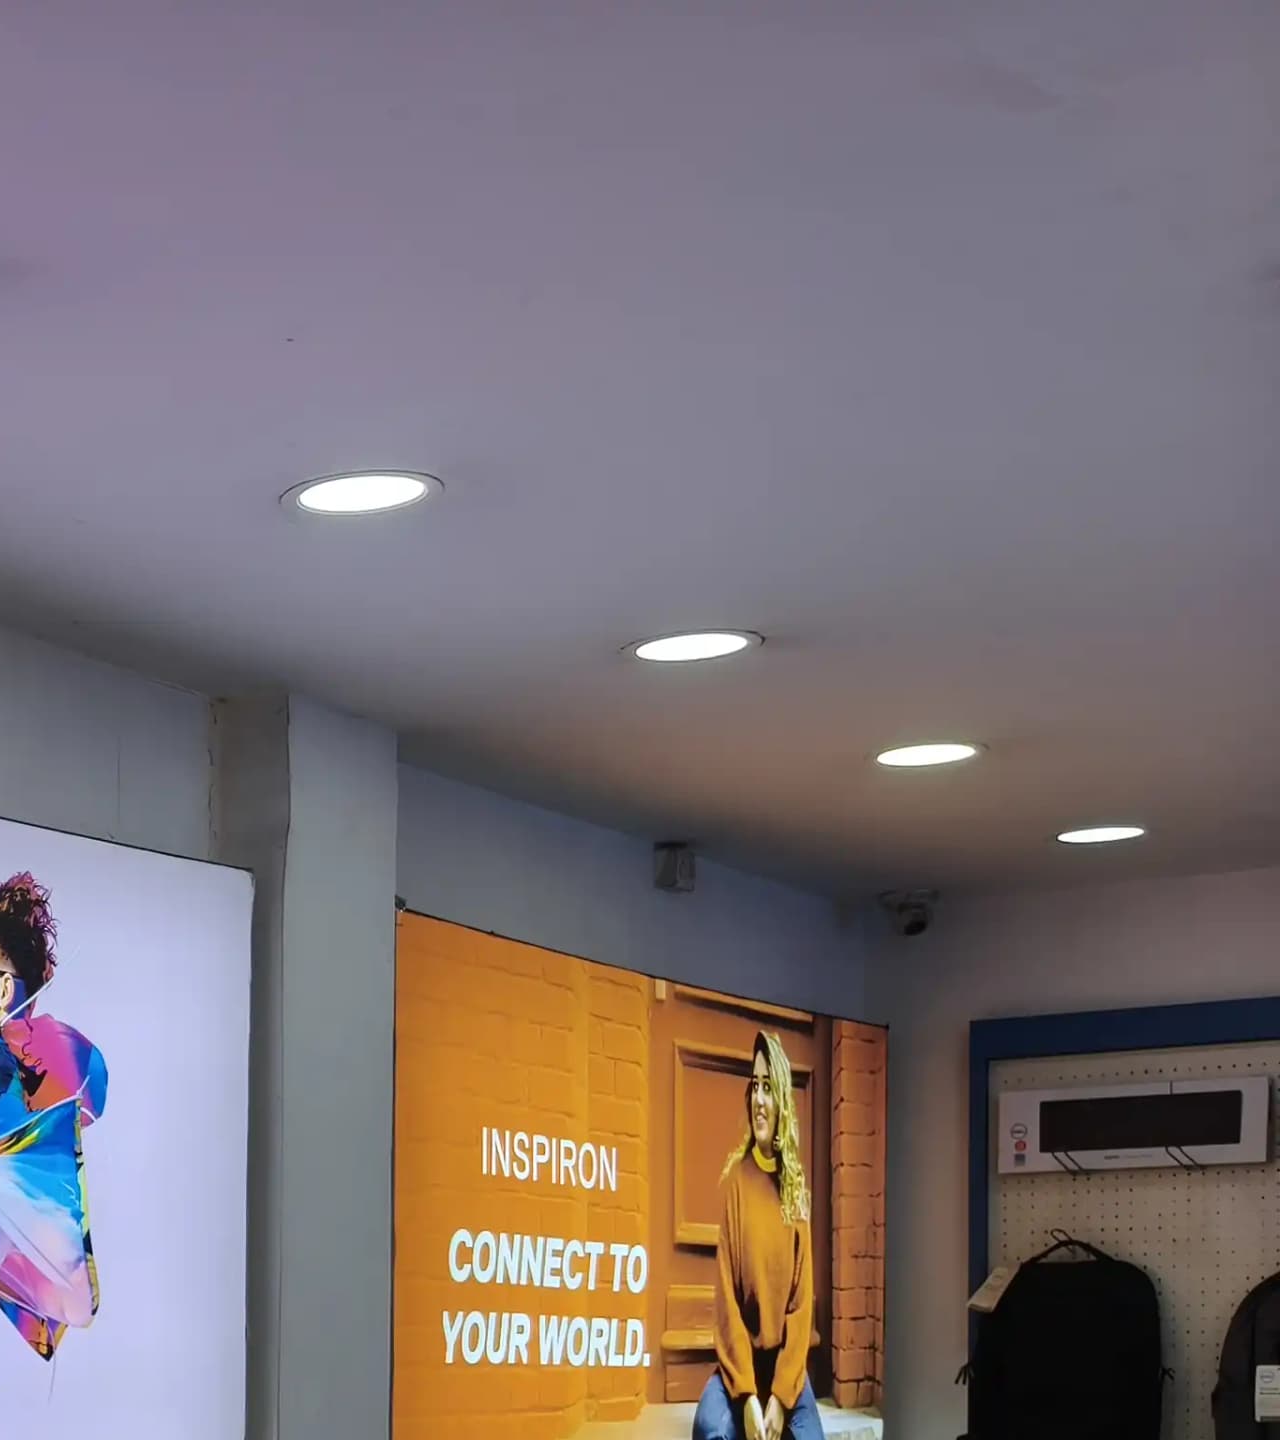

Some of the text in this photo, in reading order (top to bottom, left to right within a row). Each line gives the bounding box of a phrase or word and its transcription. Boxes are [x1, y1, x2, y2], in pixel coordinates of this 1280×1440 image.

[482, 1127, 616, 1191] INSPIRON
[448, 1229, 647, 1294] CONNECT TO
[442, 1311, 650, 1367] YOUR WORLD.
